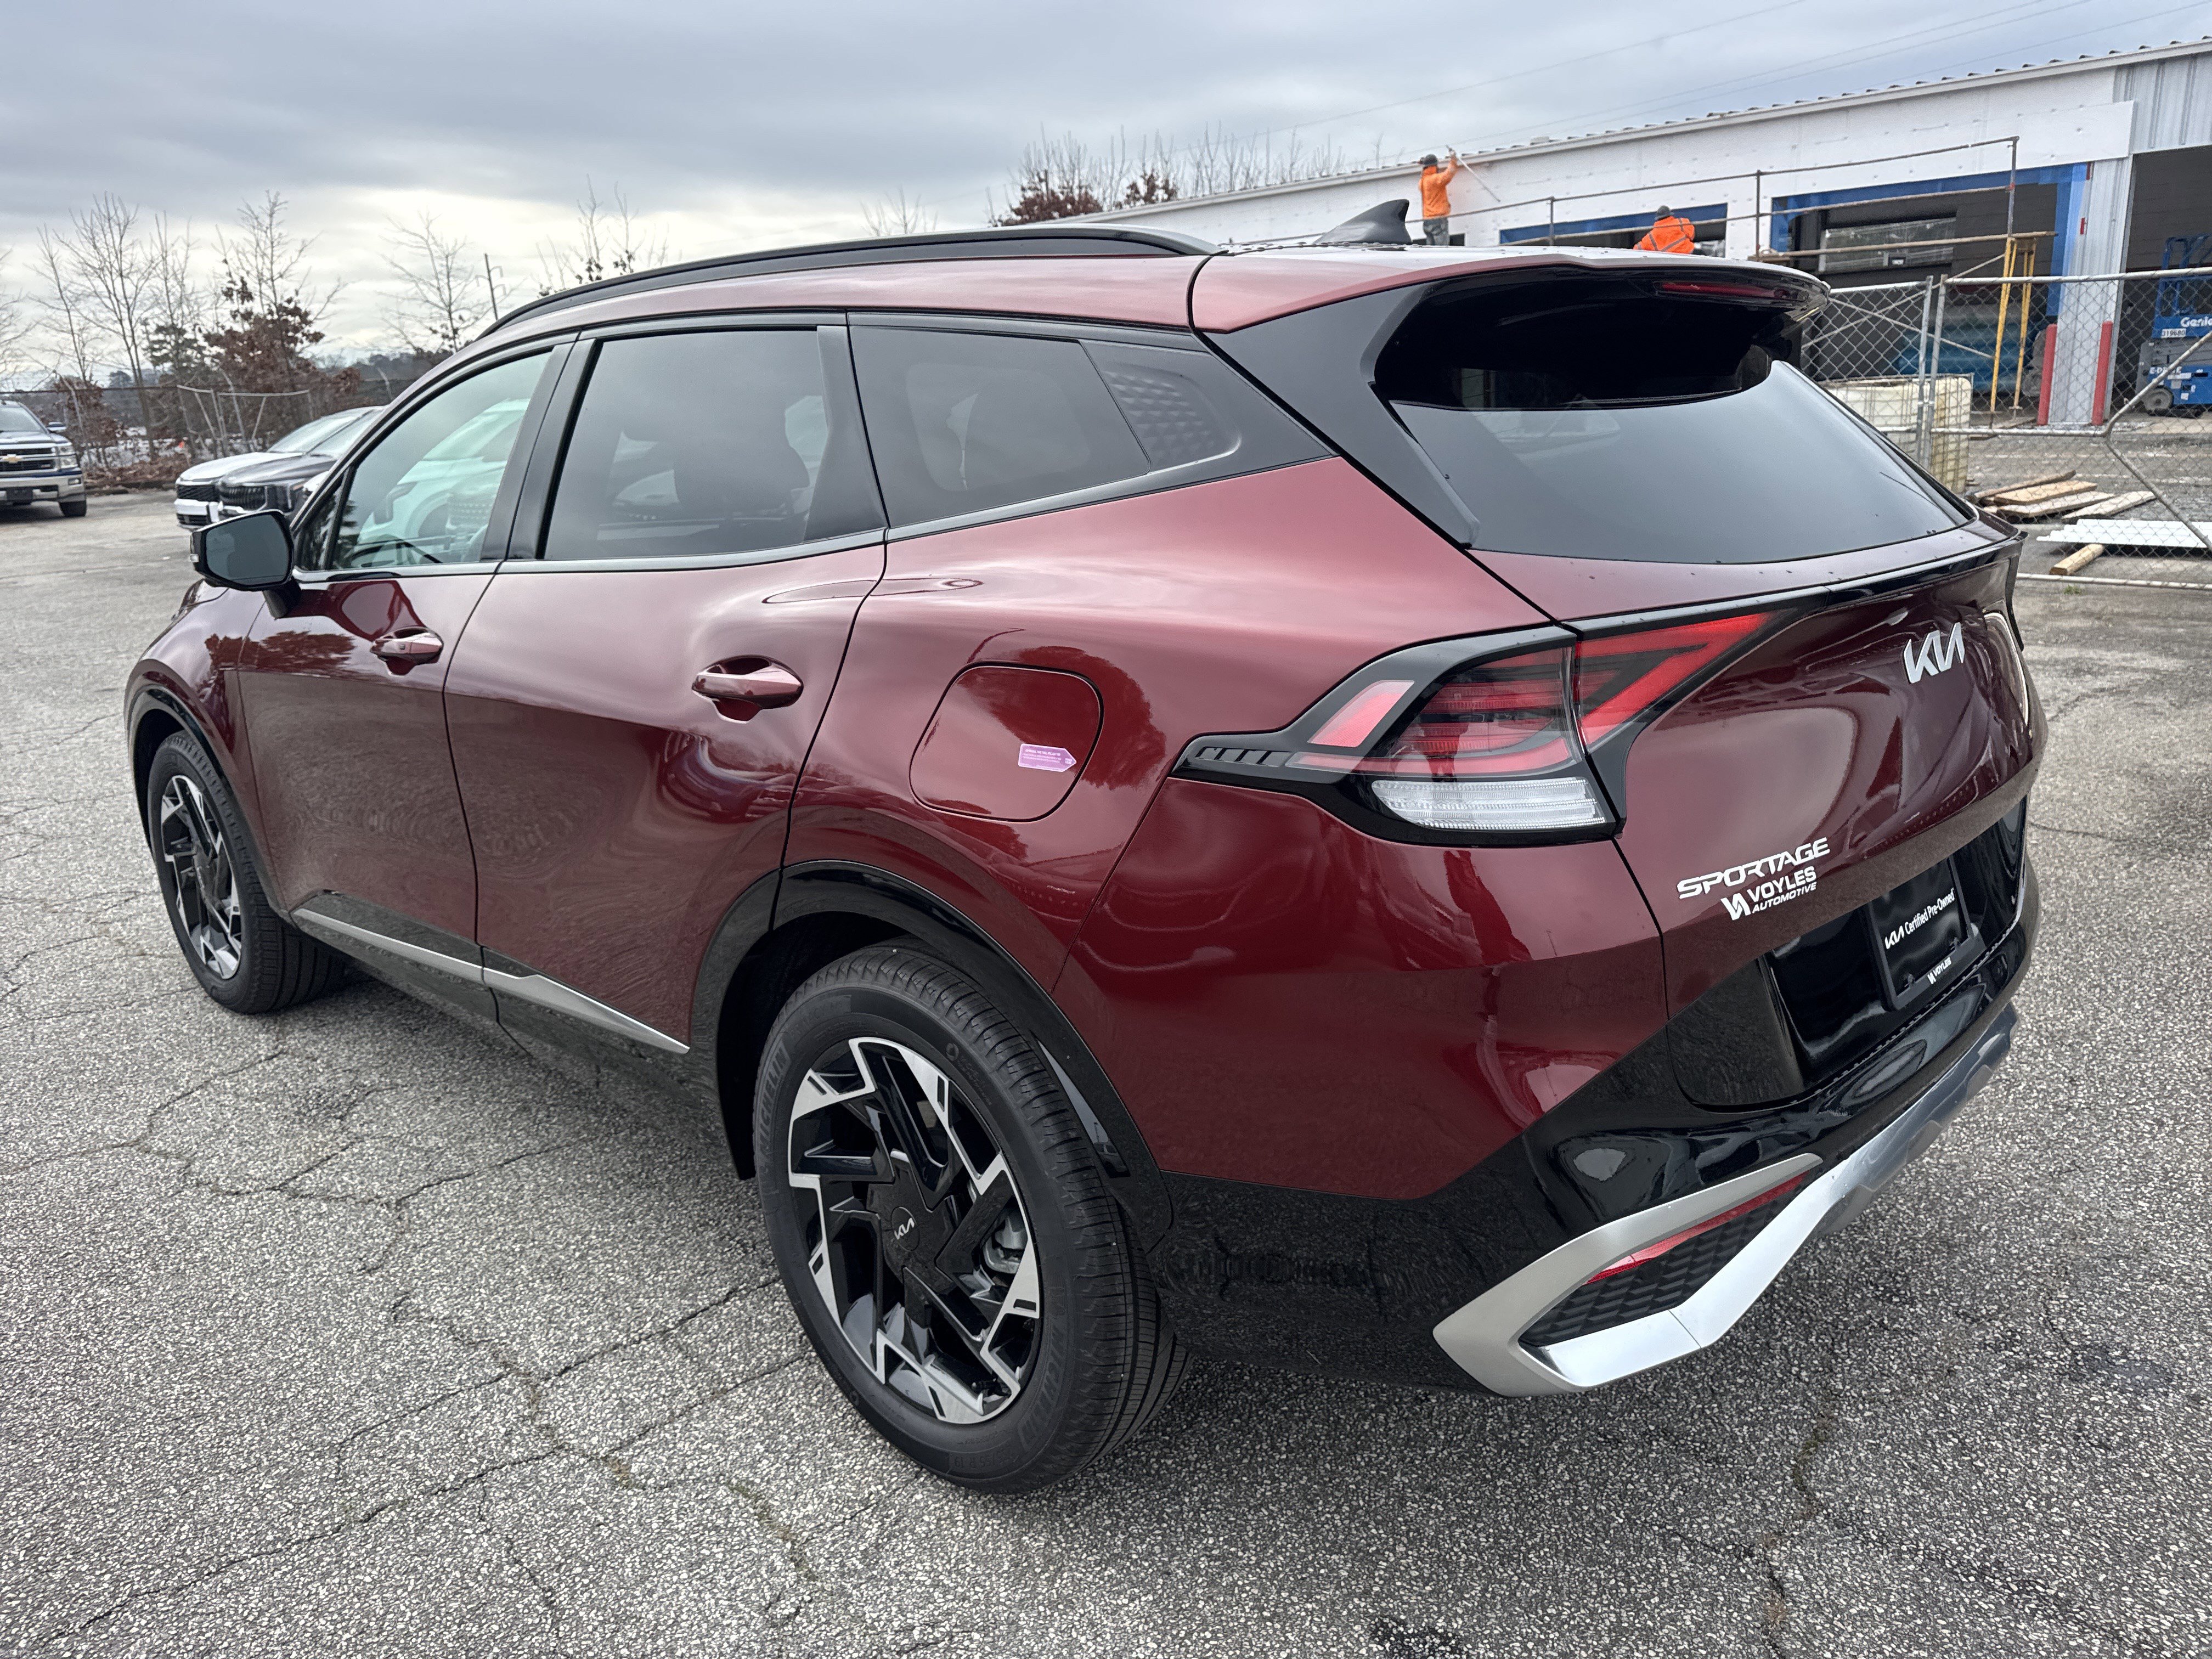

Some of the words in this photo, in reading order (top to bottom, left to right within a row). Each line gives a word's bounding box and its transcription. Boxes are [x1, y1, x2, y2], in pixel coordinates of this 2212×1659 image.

[1904, 622, 1965, 684] KIA
[1677, 837, 1830, 899] SPORTAGE
[1747, 866, 1816, 902] VOYLES
[1752, 881, 1817, 913] AUTOMOTIVE
[1905, 908, 1929, 934] Certified
[1927, 887, 1955, 918] Pre-Owned
[1933, 957, 1951, 977] VOYLES
